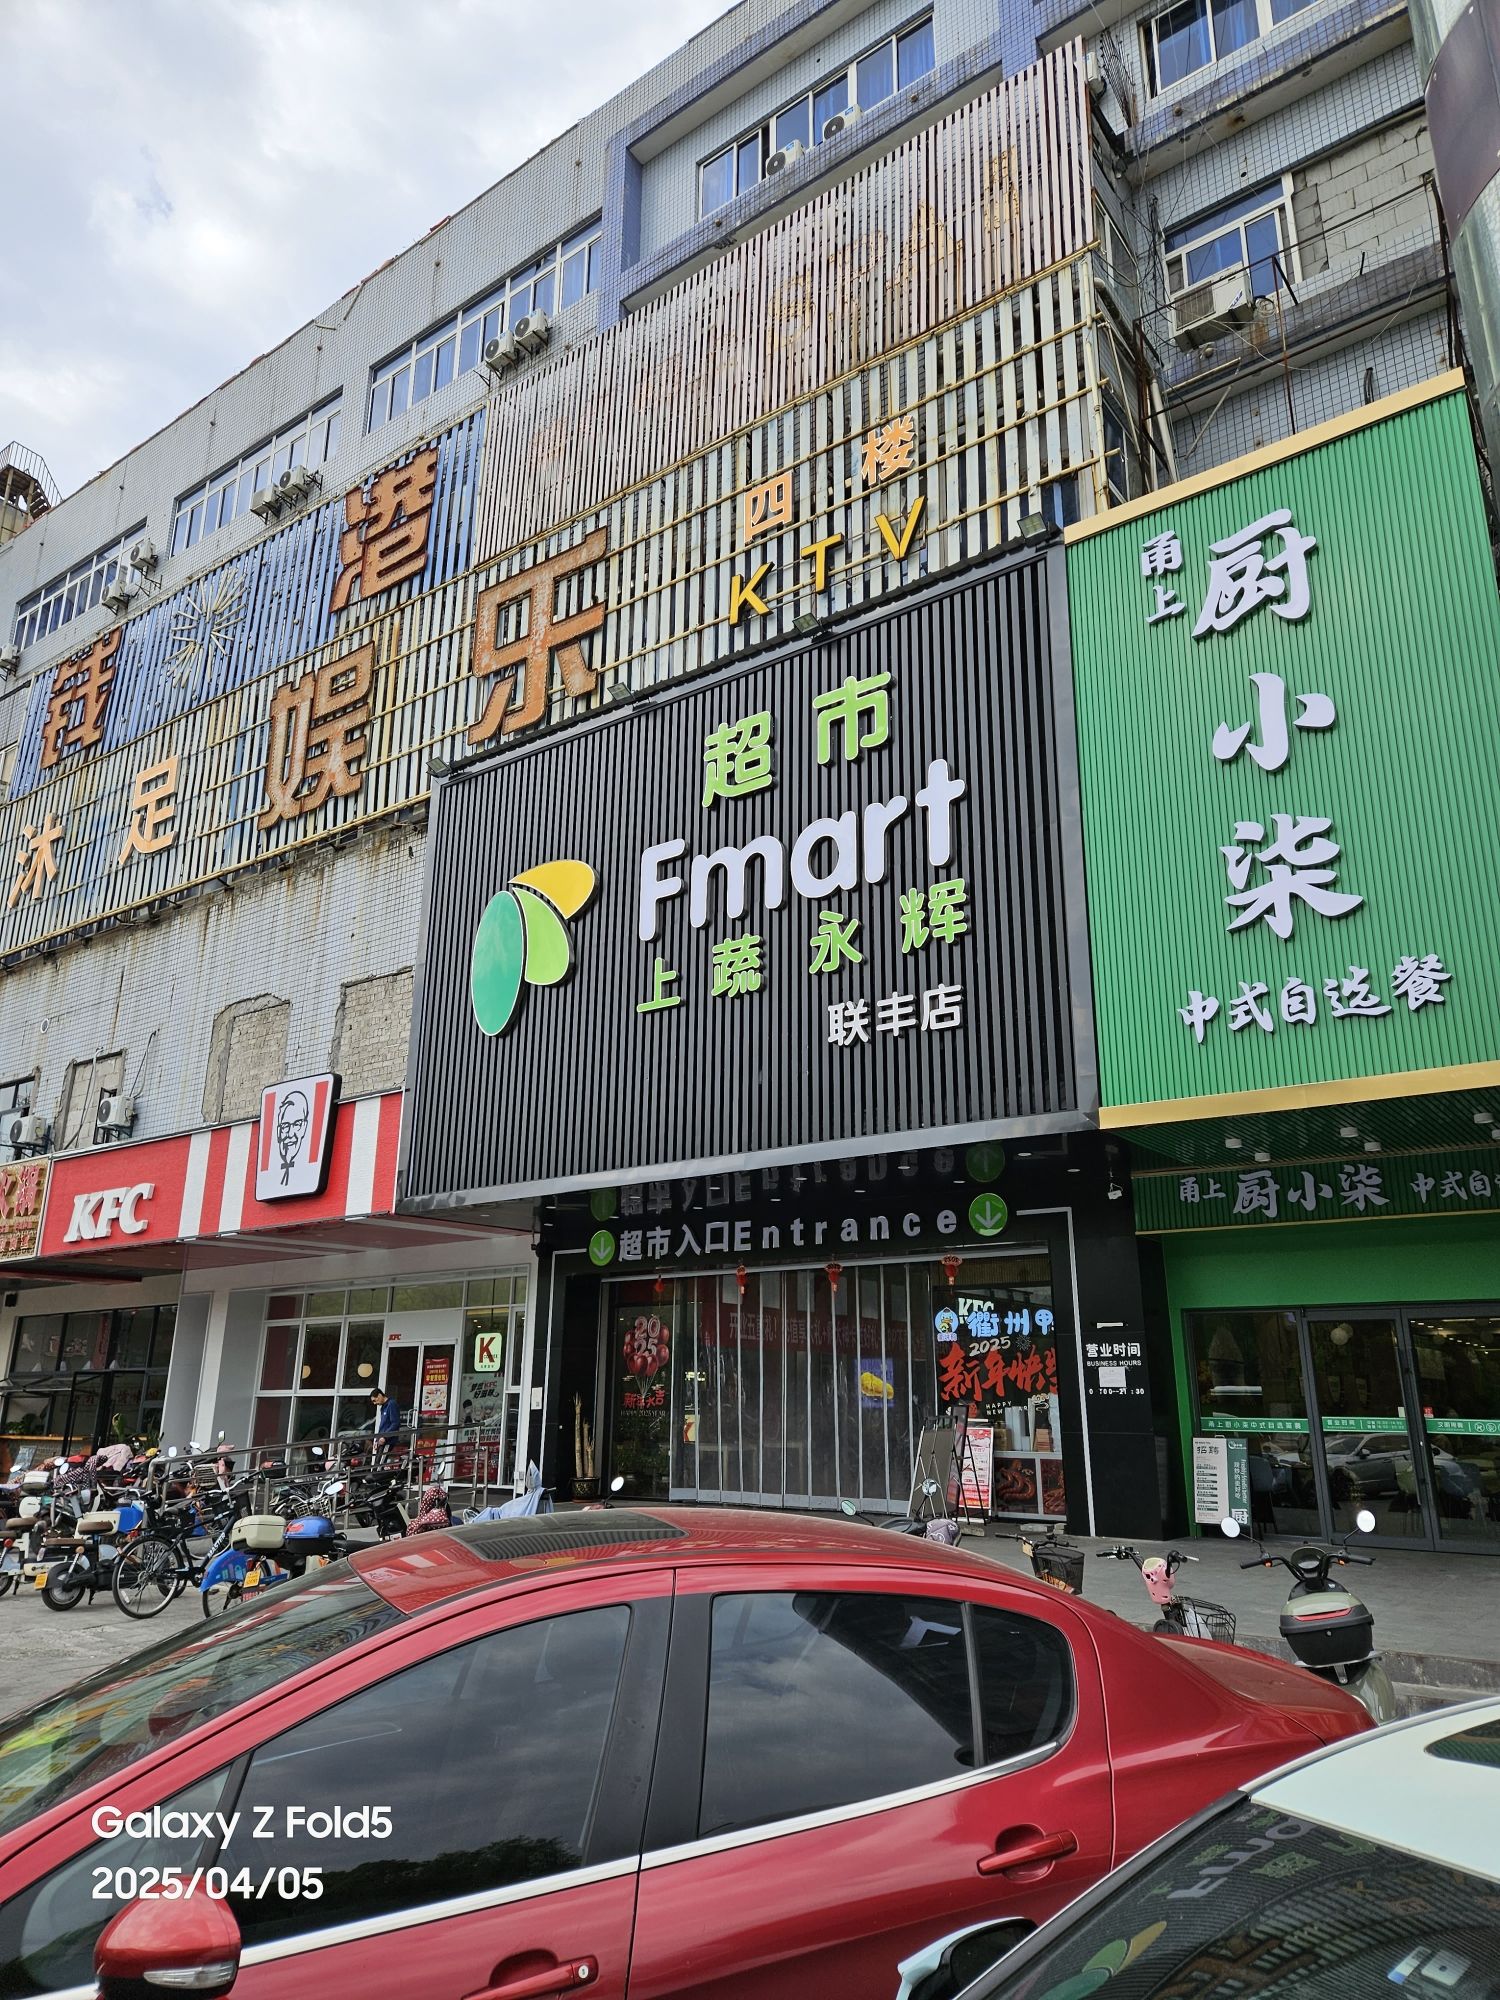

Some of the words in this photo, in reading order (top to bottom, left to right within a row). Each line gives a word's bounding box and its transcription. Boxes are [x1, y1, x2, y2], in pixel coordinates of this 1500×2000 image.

[743, 416, 917, 542] 四楼
[729, 496, 926, 626] KTV
[1141, 529, 1187, 626] 甬上
[258, 526, 608, 831] 娱乐
[1192, 508, 1364, 940] 厨小柒
[703, 671, 893, 808] 超市
[9, 755, 181, 909] 沐足
[638, 758, 966, 943] Fmart
[636, 878, 968, 1013] 上蔬永辉
[827, 983, 963, 1046] 联丰店
[1176, 953, 1452, 1045] 中式自选餐
[64, 1183, 155, 1243] KFC
[733, 1209, 958, 1252] Entrance
[1233, 1163, 1391, 1219] 厨小柒
[1410, 1171, 1500, 1203] 中式自
[618, 1221, 730, 1262] 超市入口
[969, 1335, 1011, 1357] 2025
[1085, 1342, 1141, 1358] 营业时间
